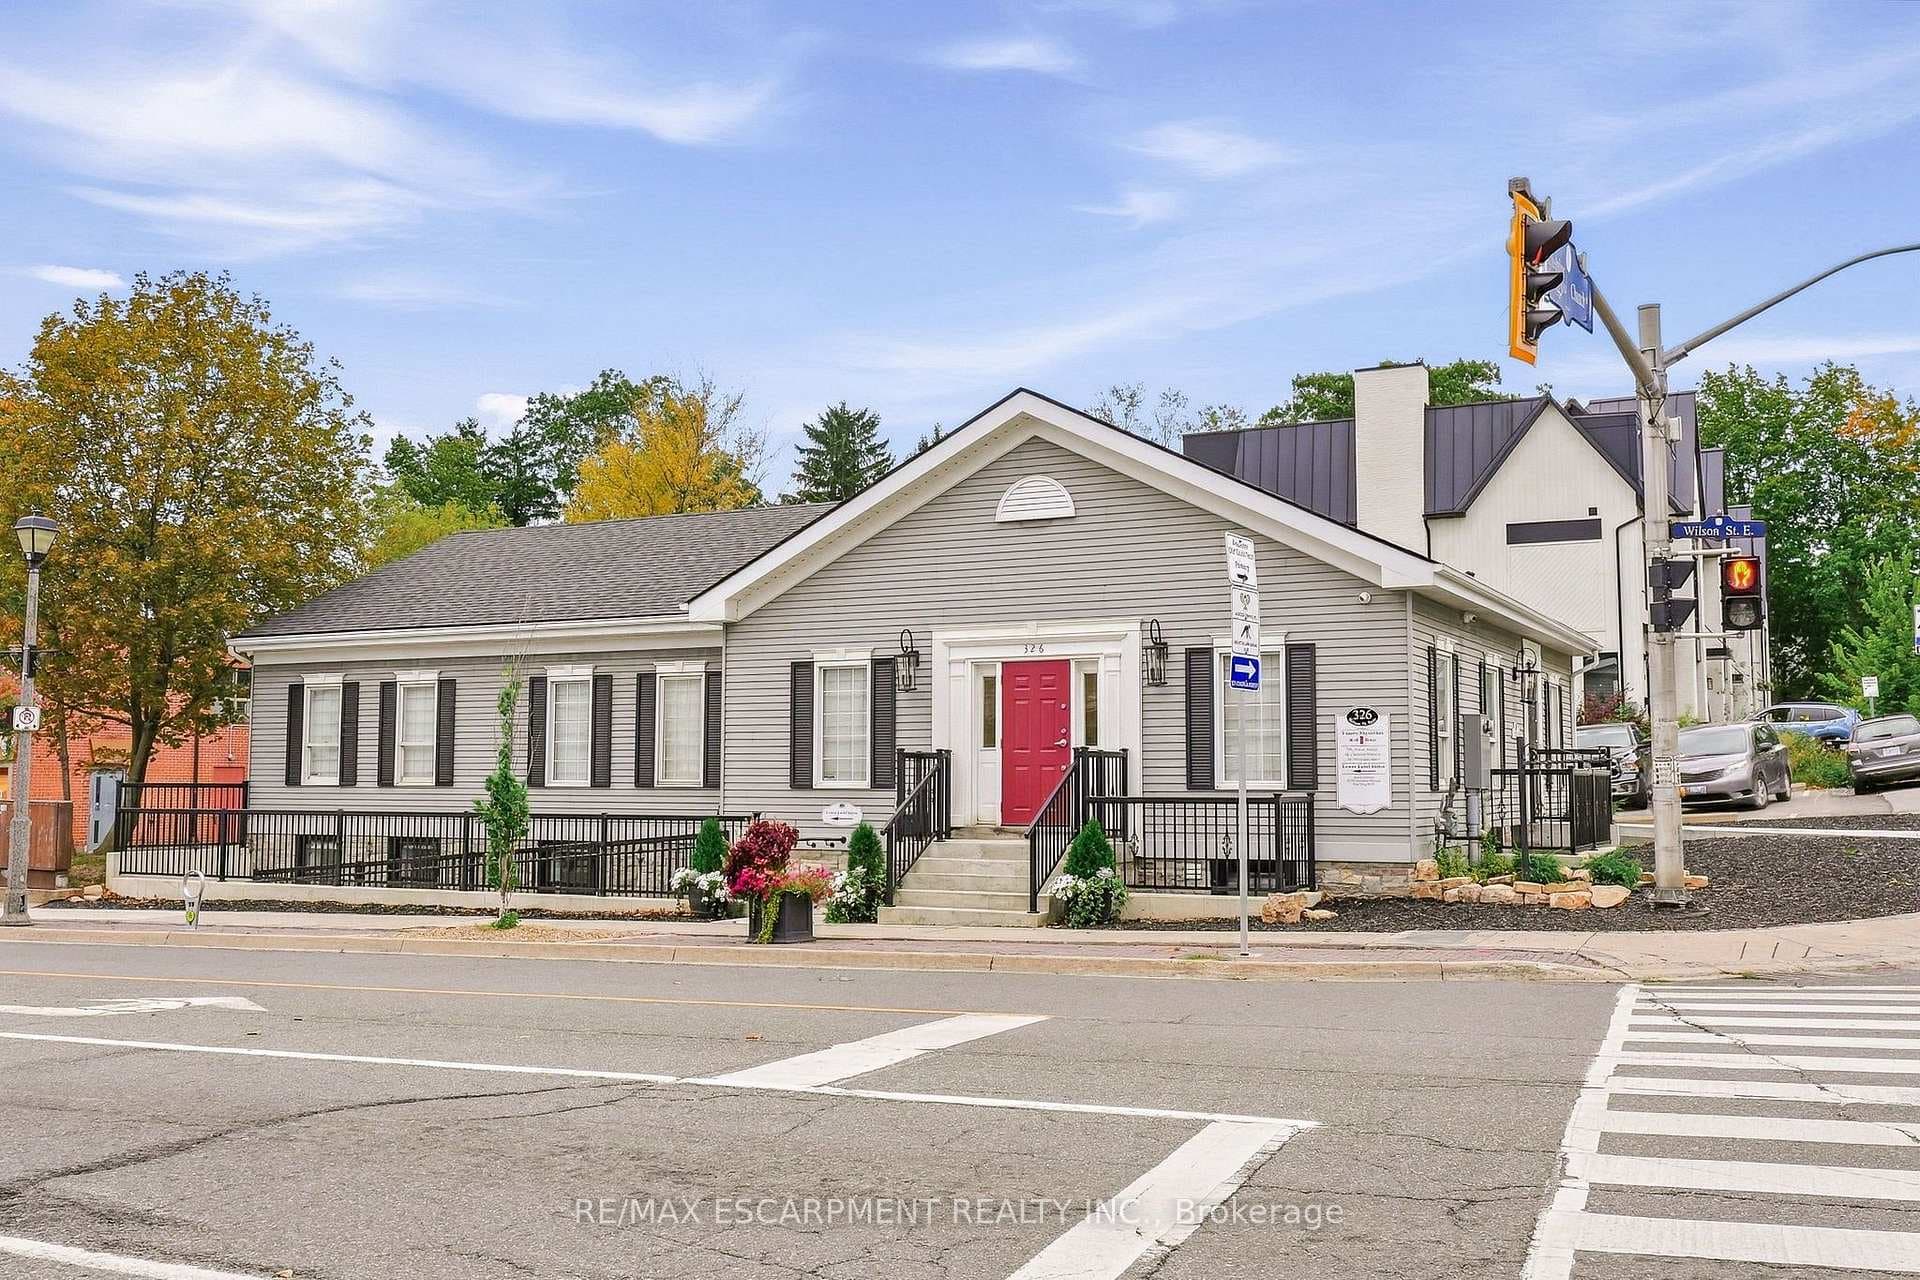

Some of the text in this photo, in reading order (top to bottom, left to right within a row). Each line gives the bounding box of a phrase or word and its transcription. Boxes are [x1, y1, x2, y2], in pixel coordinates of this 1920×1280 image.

[1683, 525, 1754, 536] Wilson St. E.
[1024, 643, 1044, 653] 326
[1352, 709, 1373, 720] 326
